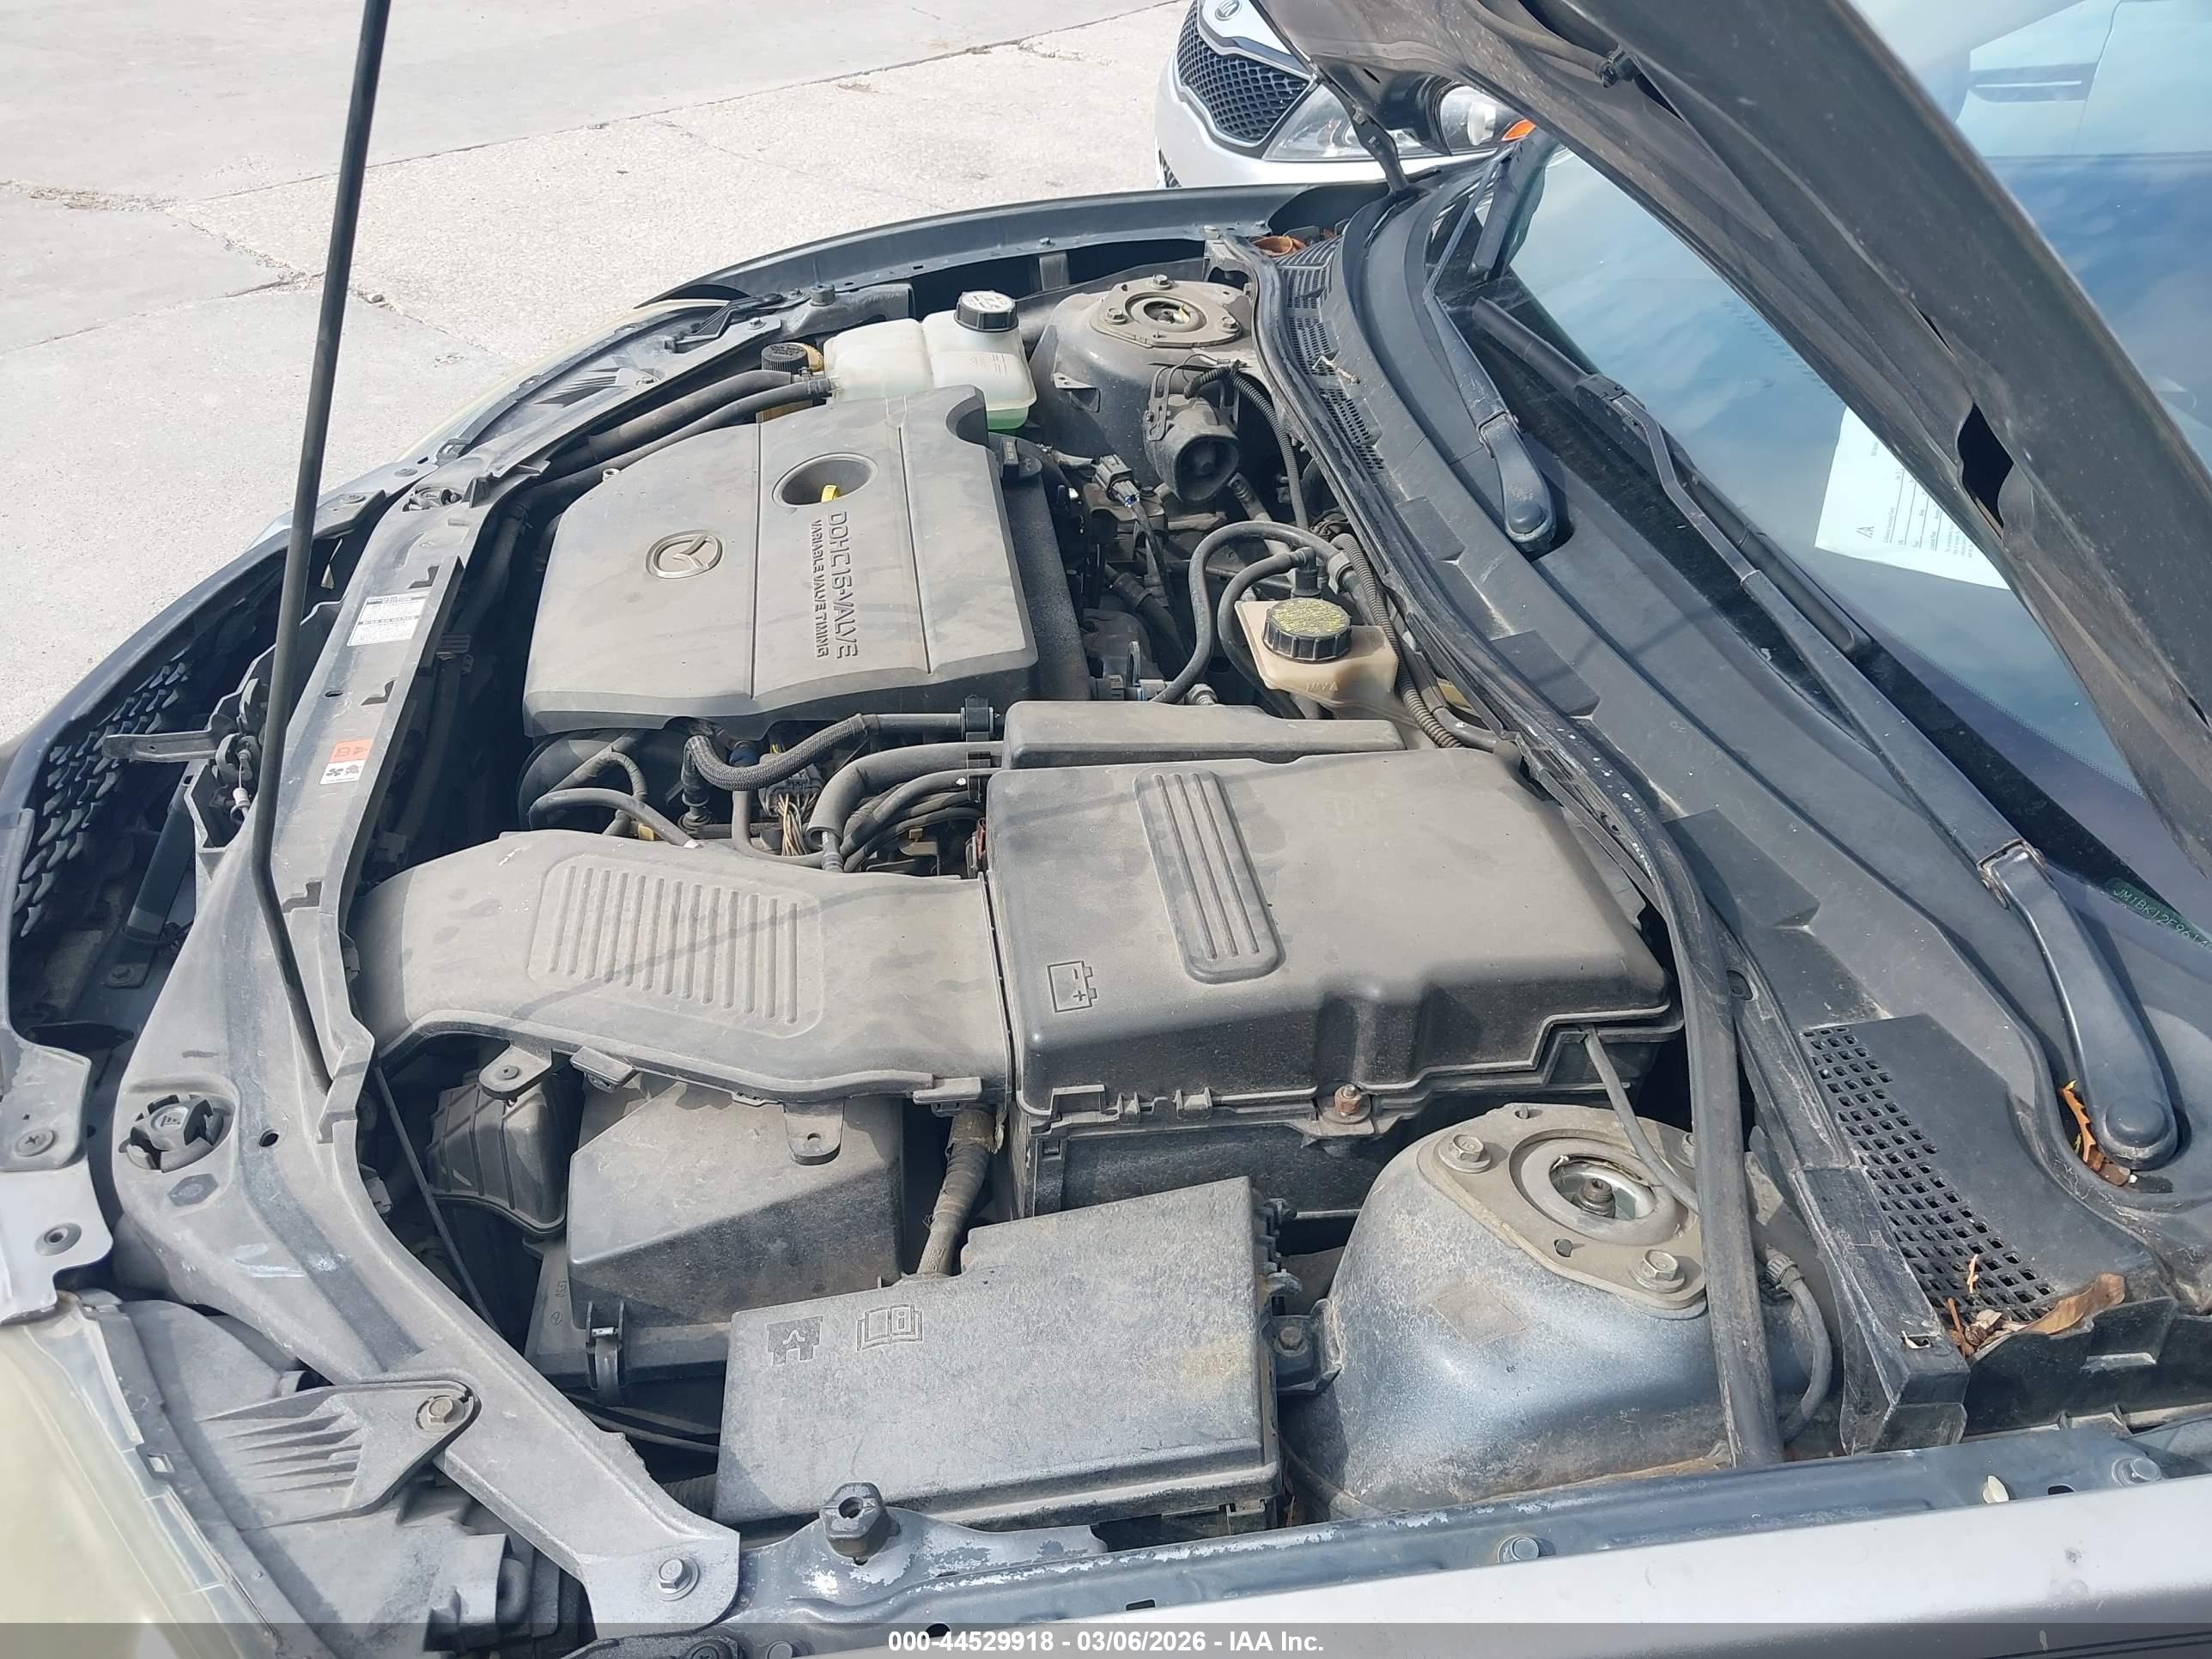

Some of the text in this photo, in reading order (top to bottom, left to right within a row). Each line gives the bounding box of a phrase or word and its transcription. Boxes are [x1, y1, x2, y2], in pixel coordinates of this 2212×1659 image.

[811, 520, 830, 659] VARIABLE VALVE TIMING
[829, 511, 859, 659] DOHC 16-VALVE
